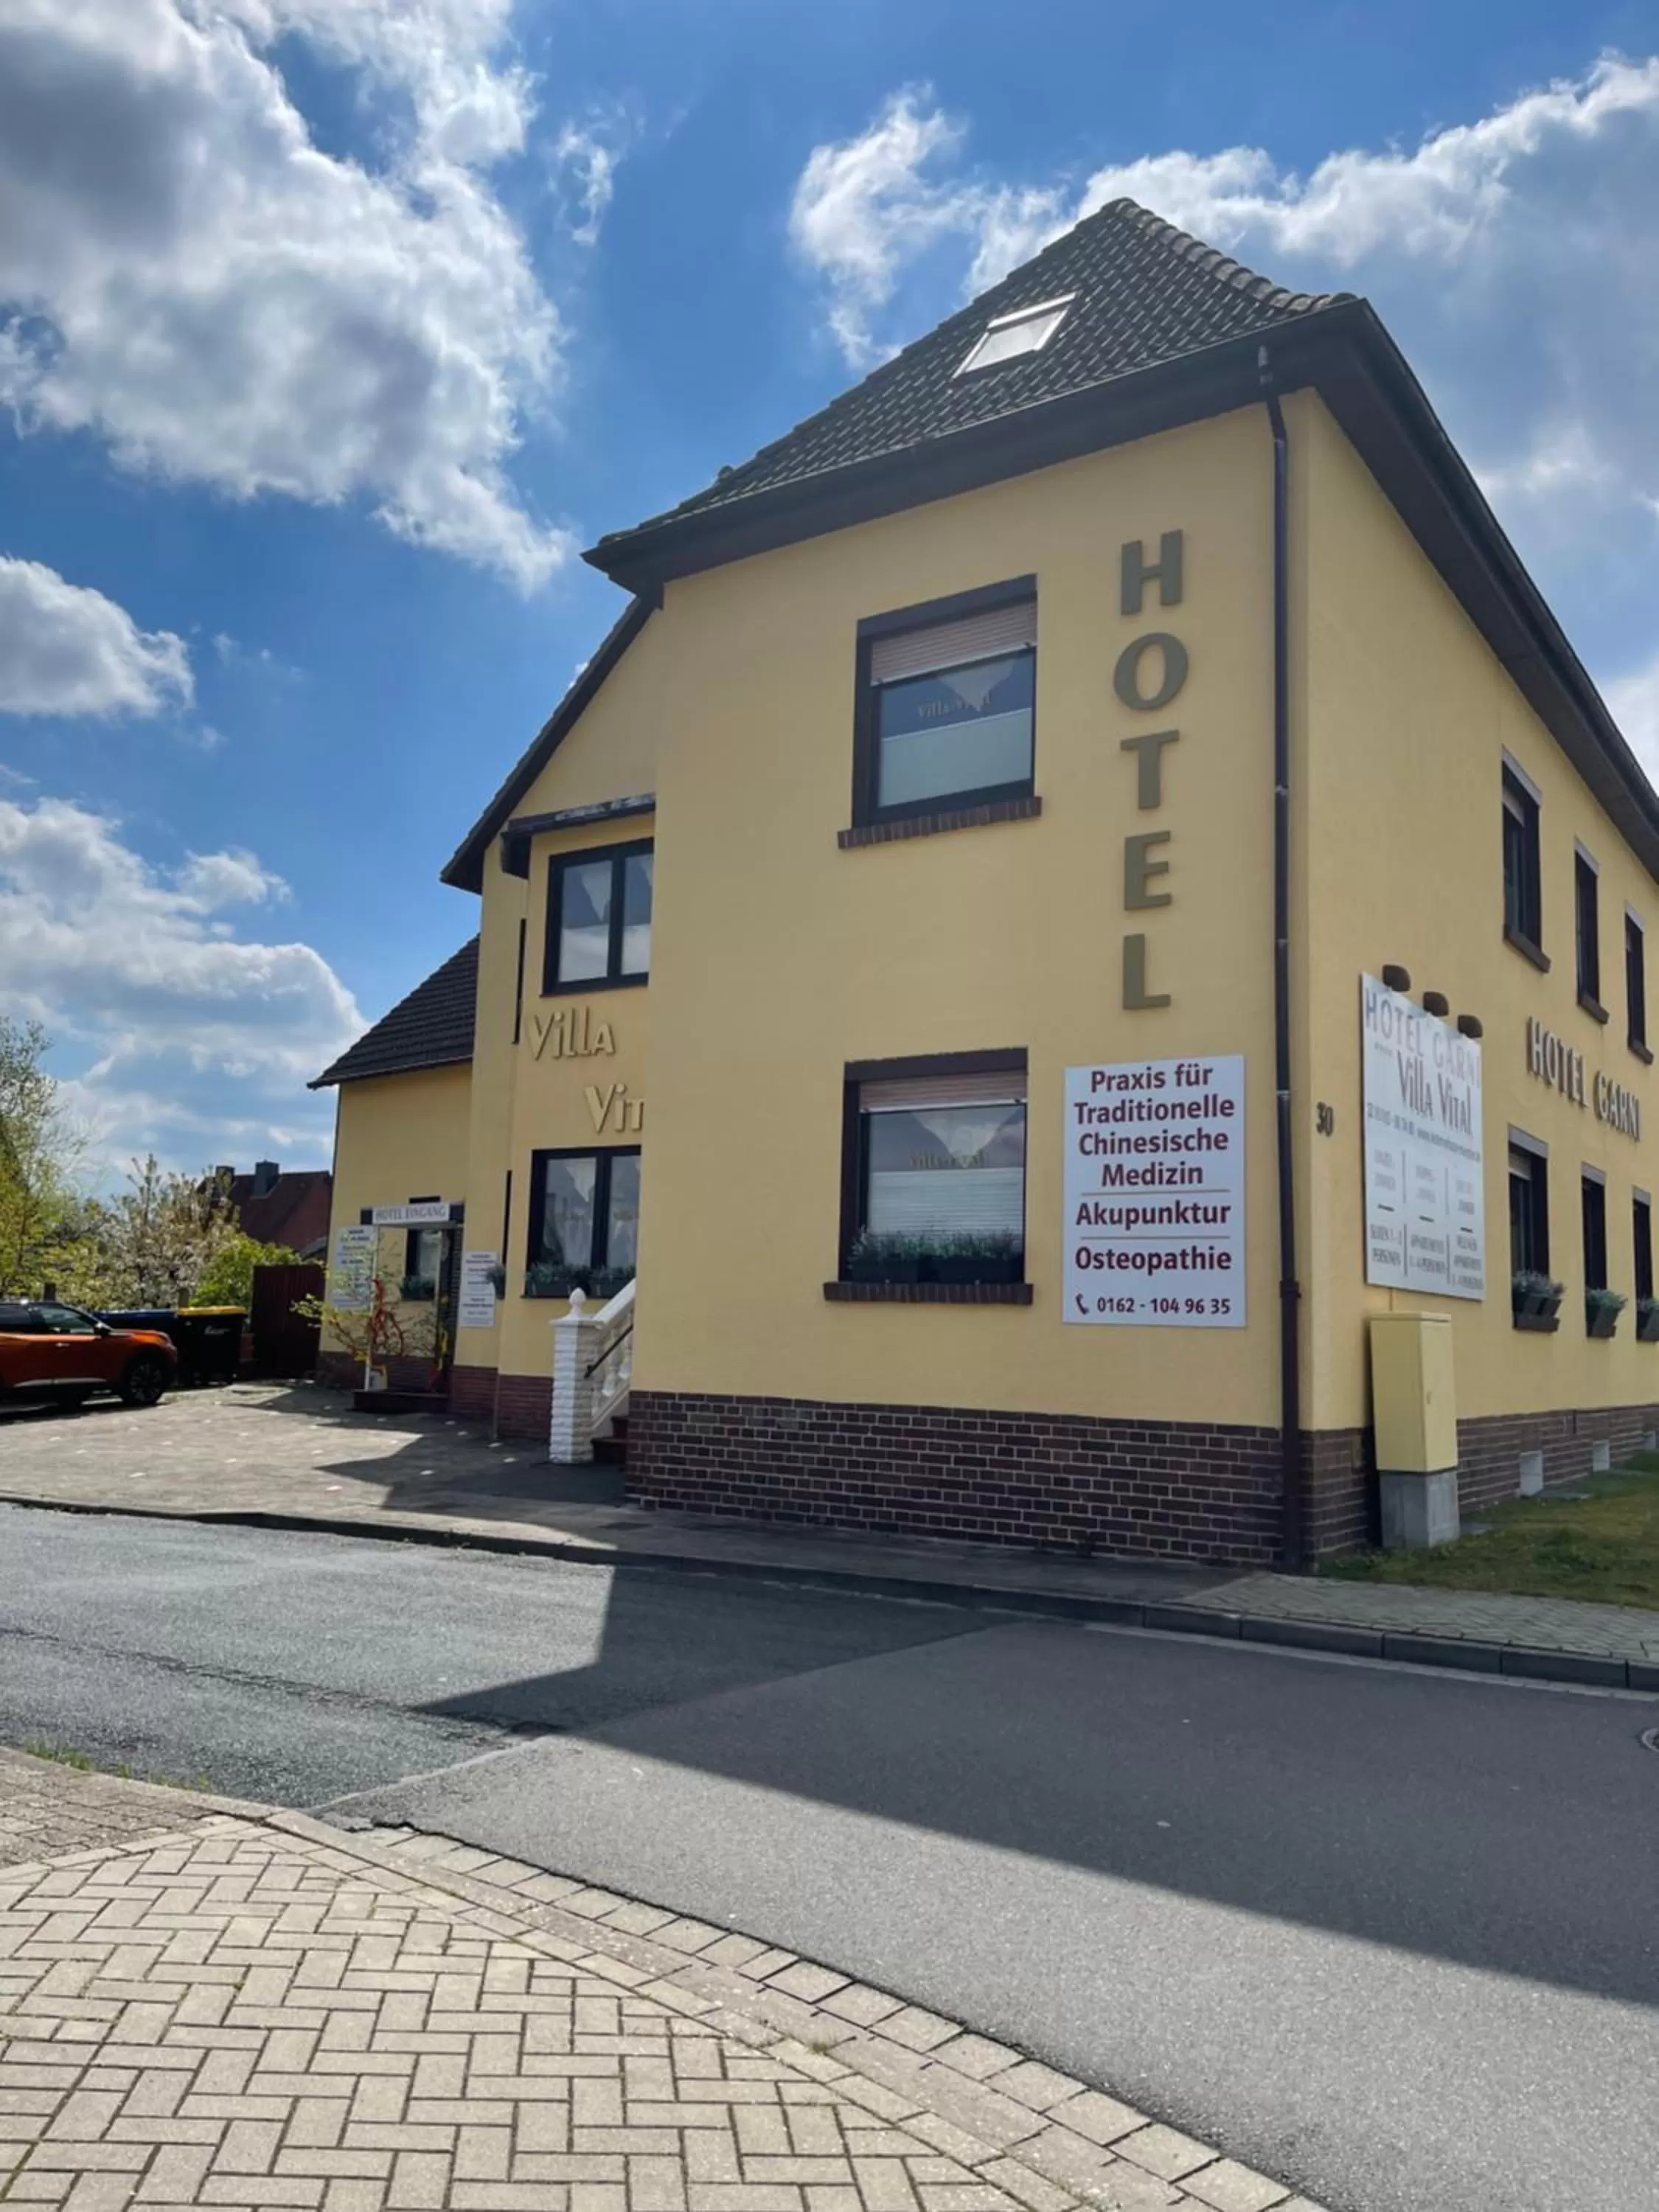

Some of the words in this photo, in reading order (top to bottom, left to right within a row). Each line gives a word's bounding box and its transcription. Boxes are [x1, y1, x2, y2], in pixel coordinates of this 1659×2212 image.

[1113, 528, 1189, 1009] HOTEL
[1366, 987, 1423, 1057] HOTEL
[1433, 1032, 1481, 1090] GARNI
[1091, 1067, 1166, 1093] Praxis
[1175, 1063, 1214, 1088] für
[1526, 1016, 1587, 1109] HOTEL
[1074, 1093, 1236, 1124] Traditionelle
[1316, 1101, 1334, 1138] 30
[1079, 1127, 1229, 1155] Chinesische
[1102, 1161, 1204, 1187] Medizin
[1076, 1200, 1231, 1231] Akupunktur
[1075, 1245, 1232, 1276] Osteopathie
[1096, 1297, 1135, 1313] 0162
[1150, 1298, 1180, 1314] 104
[1184, 1298, 1205, 1315] 96
[1211, 1298, 1231, 1315] 35
